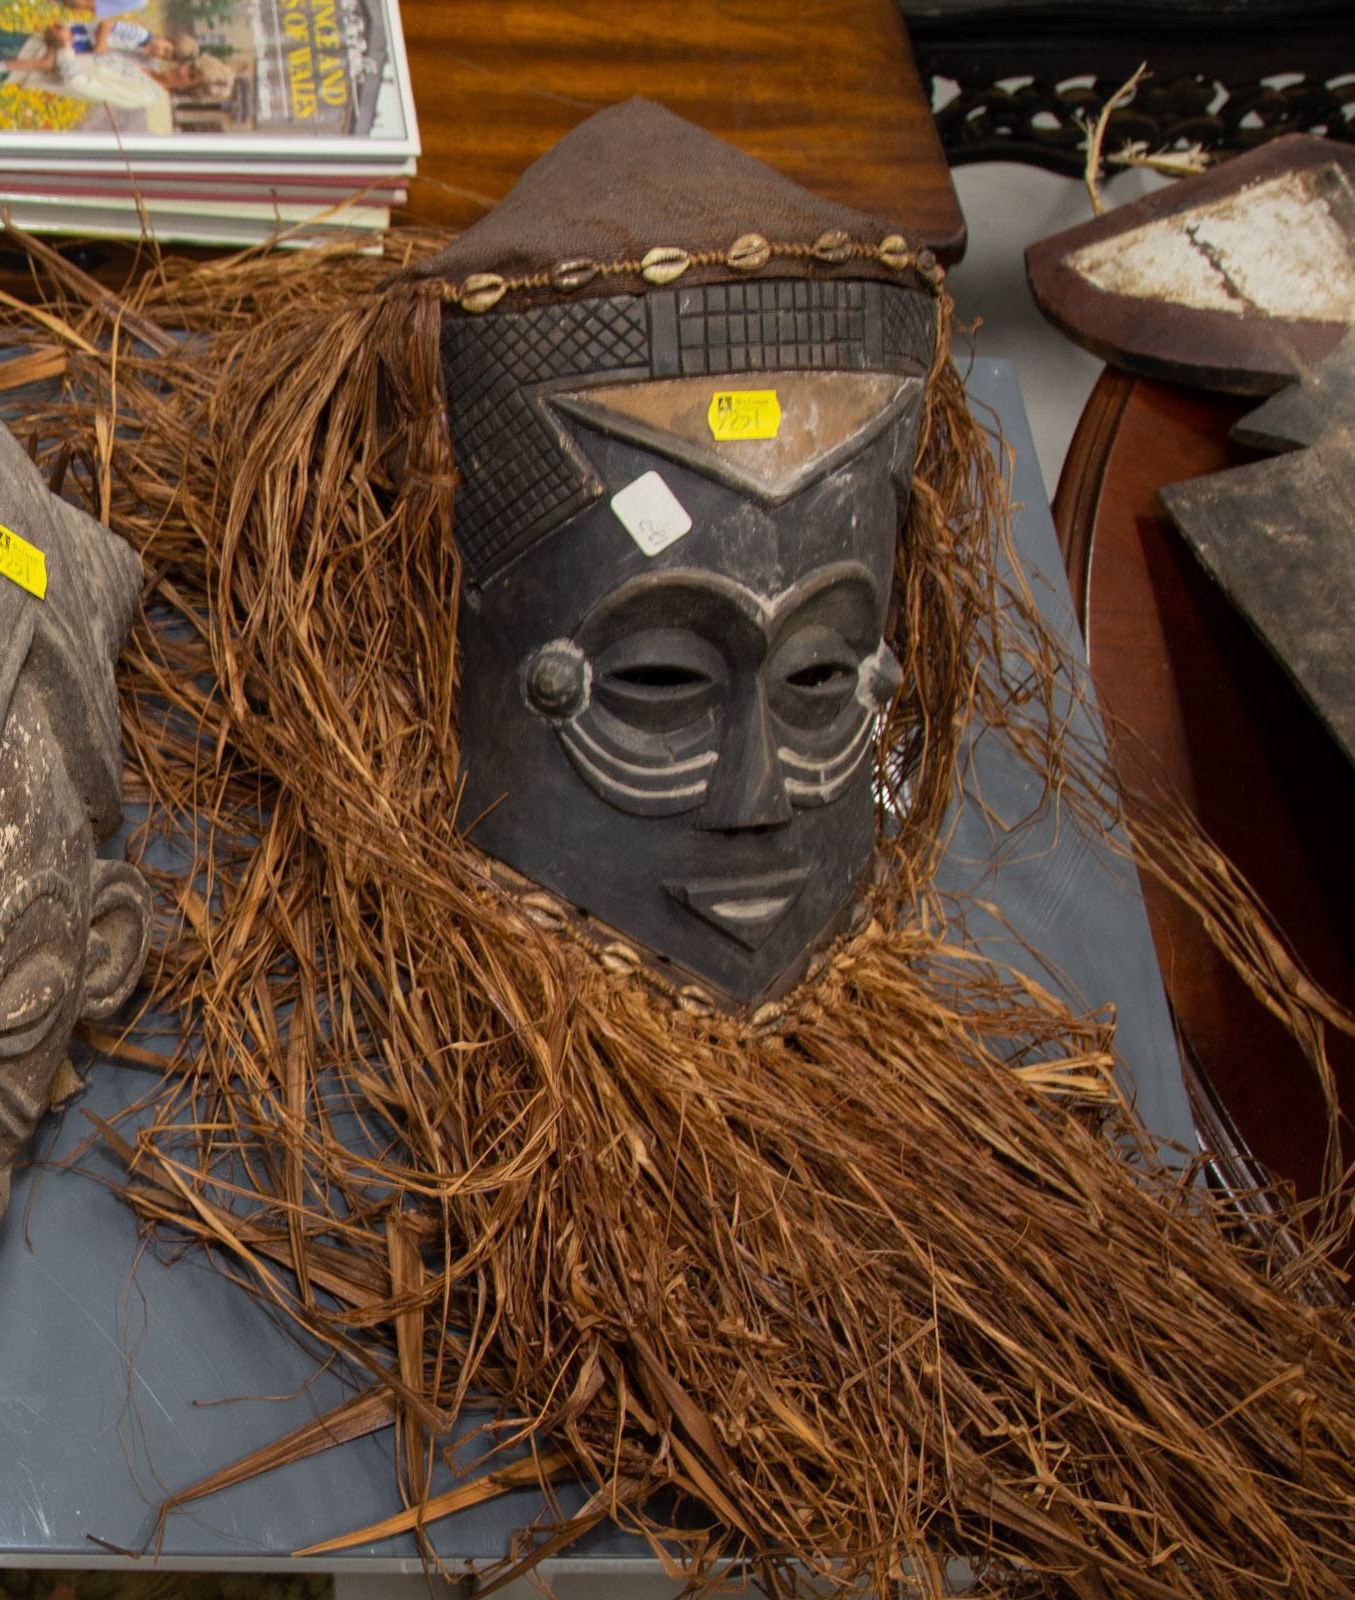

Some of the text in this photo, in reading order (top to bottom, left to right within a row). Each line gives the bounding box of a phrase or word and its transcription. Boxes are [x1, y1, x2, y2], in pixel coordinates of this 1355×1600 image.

[283, 12, 309, 42] OF
[289, 46, 319, 119] WALES
[318, 53, 347, 105] AND
